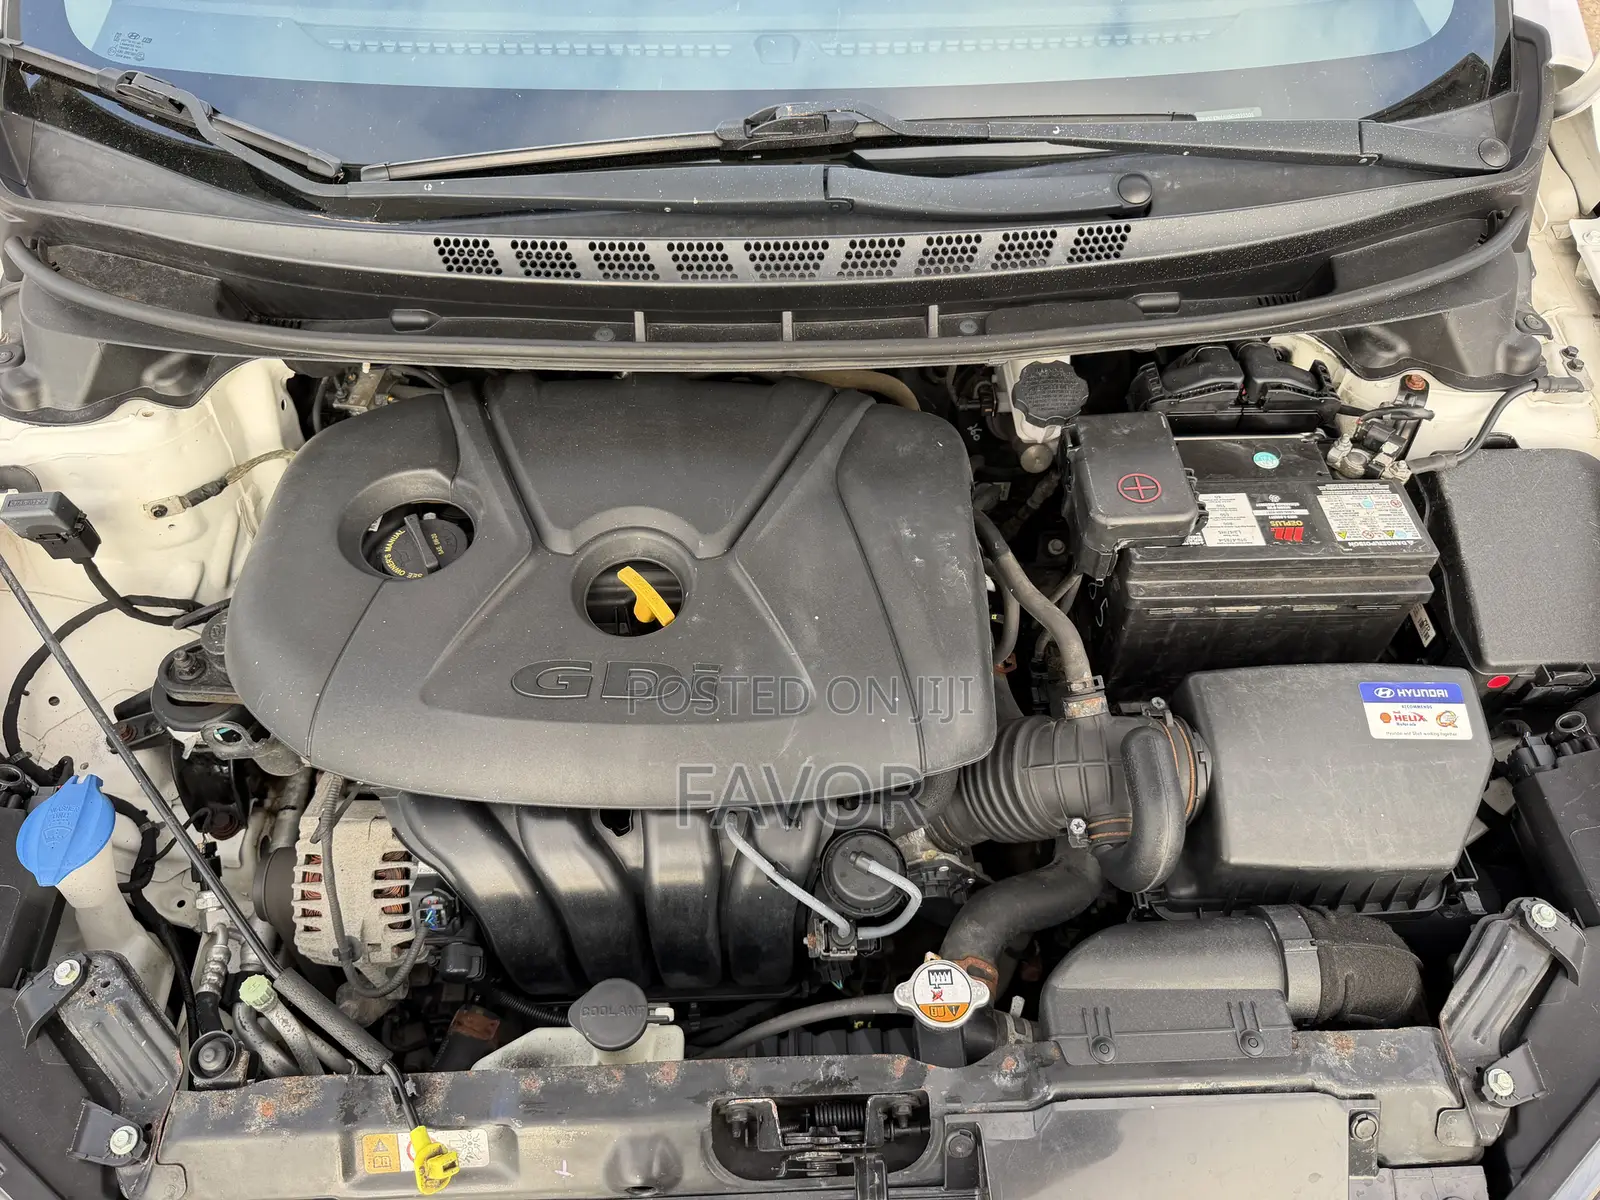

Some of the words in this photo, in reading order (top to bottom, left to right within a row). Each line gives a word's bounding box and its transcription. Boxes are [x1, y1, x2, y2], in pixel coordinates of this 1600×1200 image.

[384, 529, 406, 552] MANUAL
[1397, 688, 1449, 698] HYUNDAI
[1394, 714, 1425, 722] HELIX
[581, 1004, 646, 1017] COOLANT
